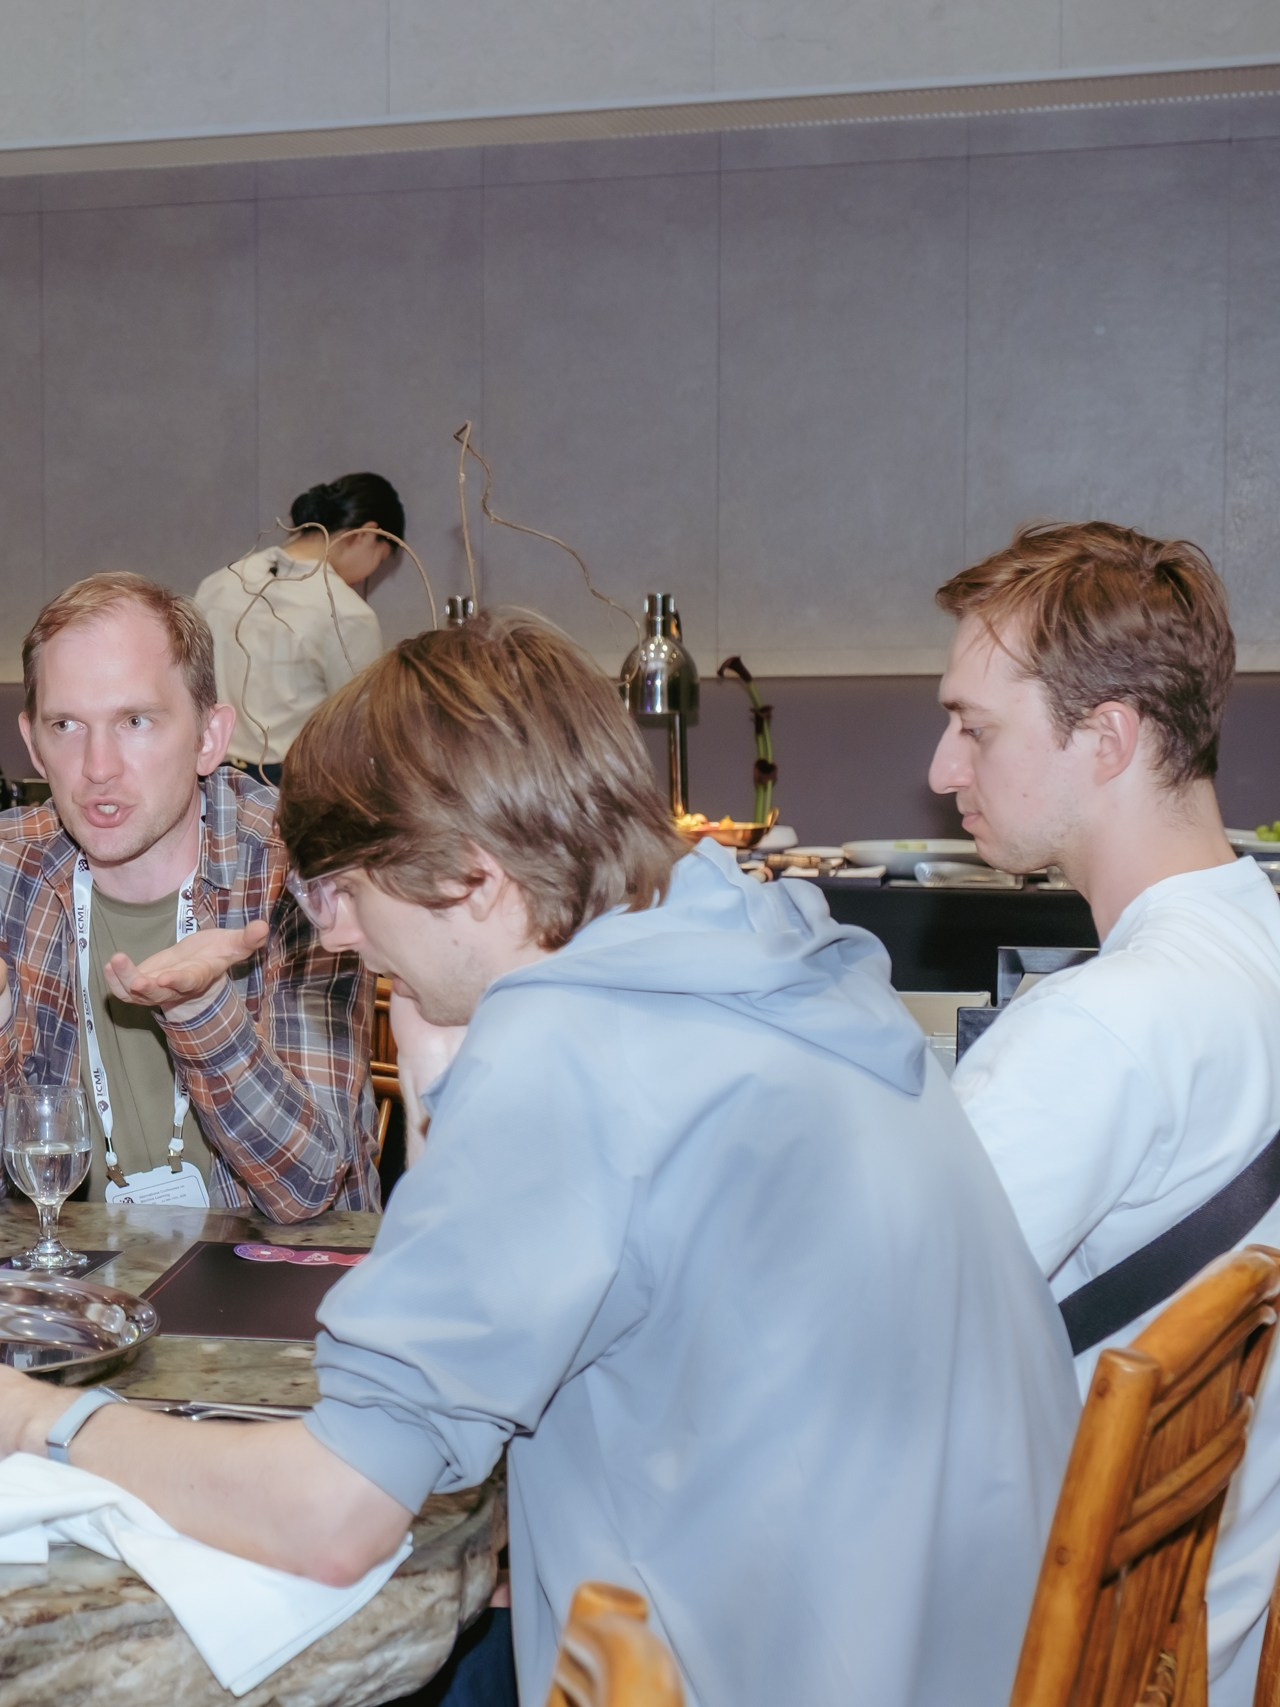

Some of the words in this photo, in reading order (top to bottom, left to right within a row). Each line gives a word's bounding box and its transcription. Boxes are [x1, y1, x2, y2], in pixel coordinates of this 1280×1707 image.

[77, 905, 85, 934] ICML
[185, 904, 195, 934] ICML
[93, 1068, 103, 1096] ICML
